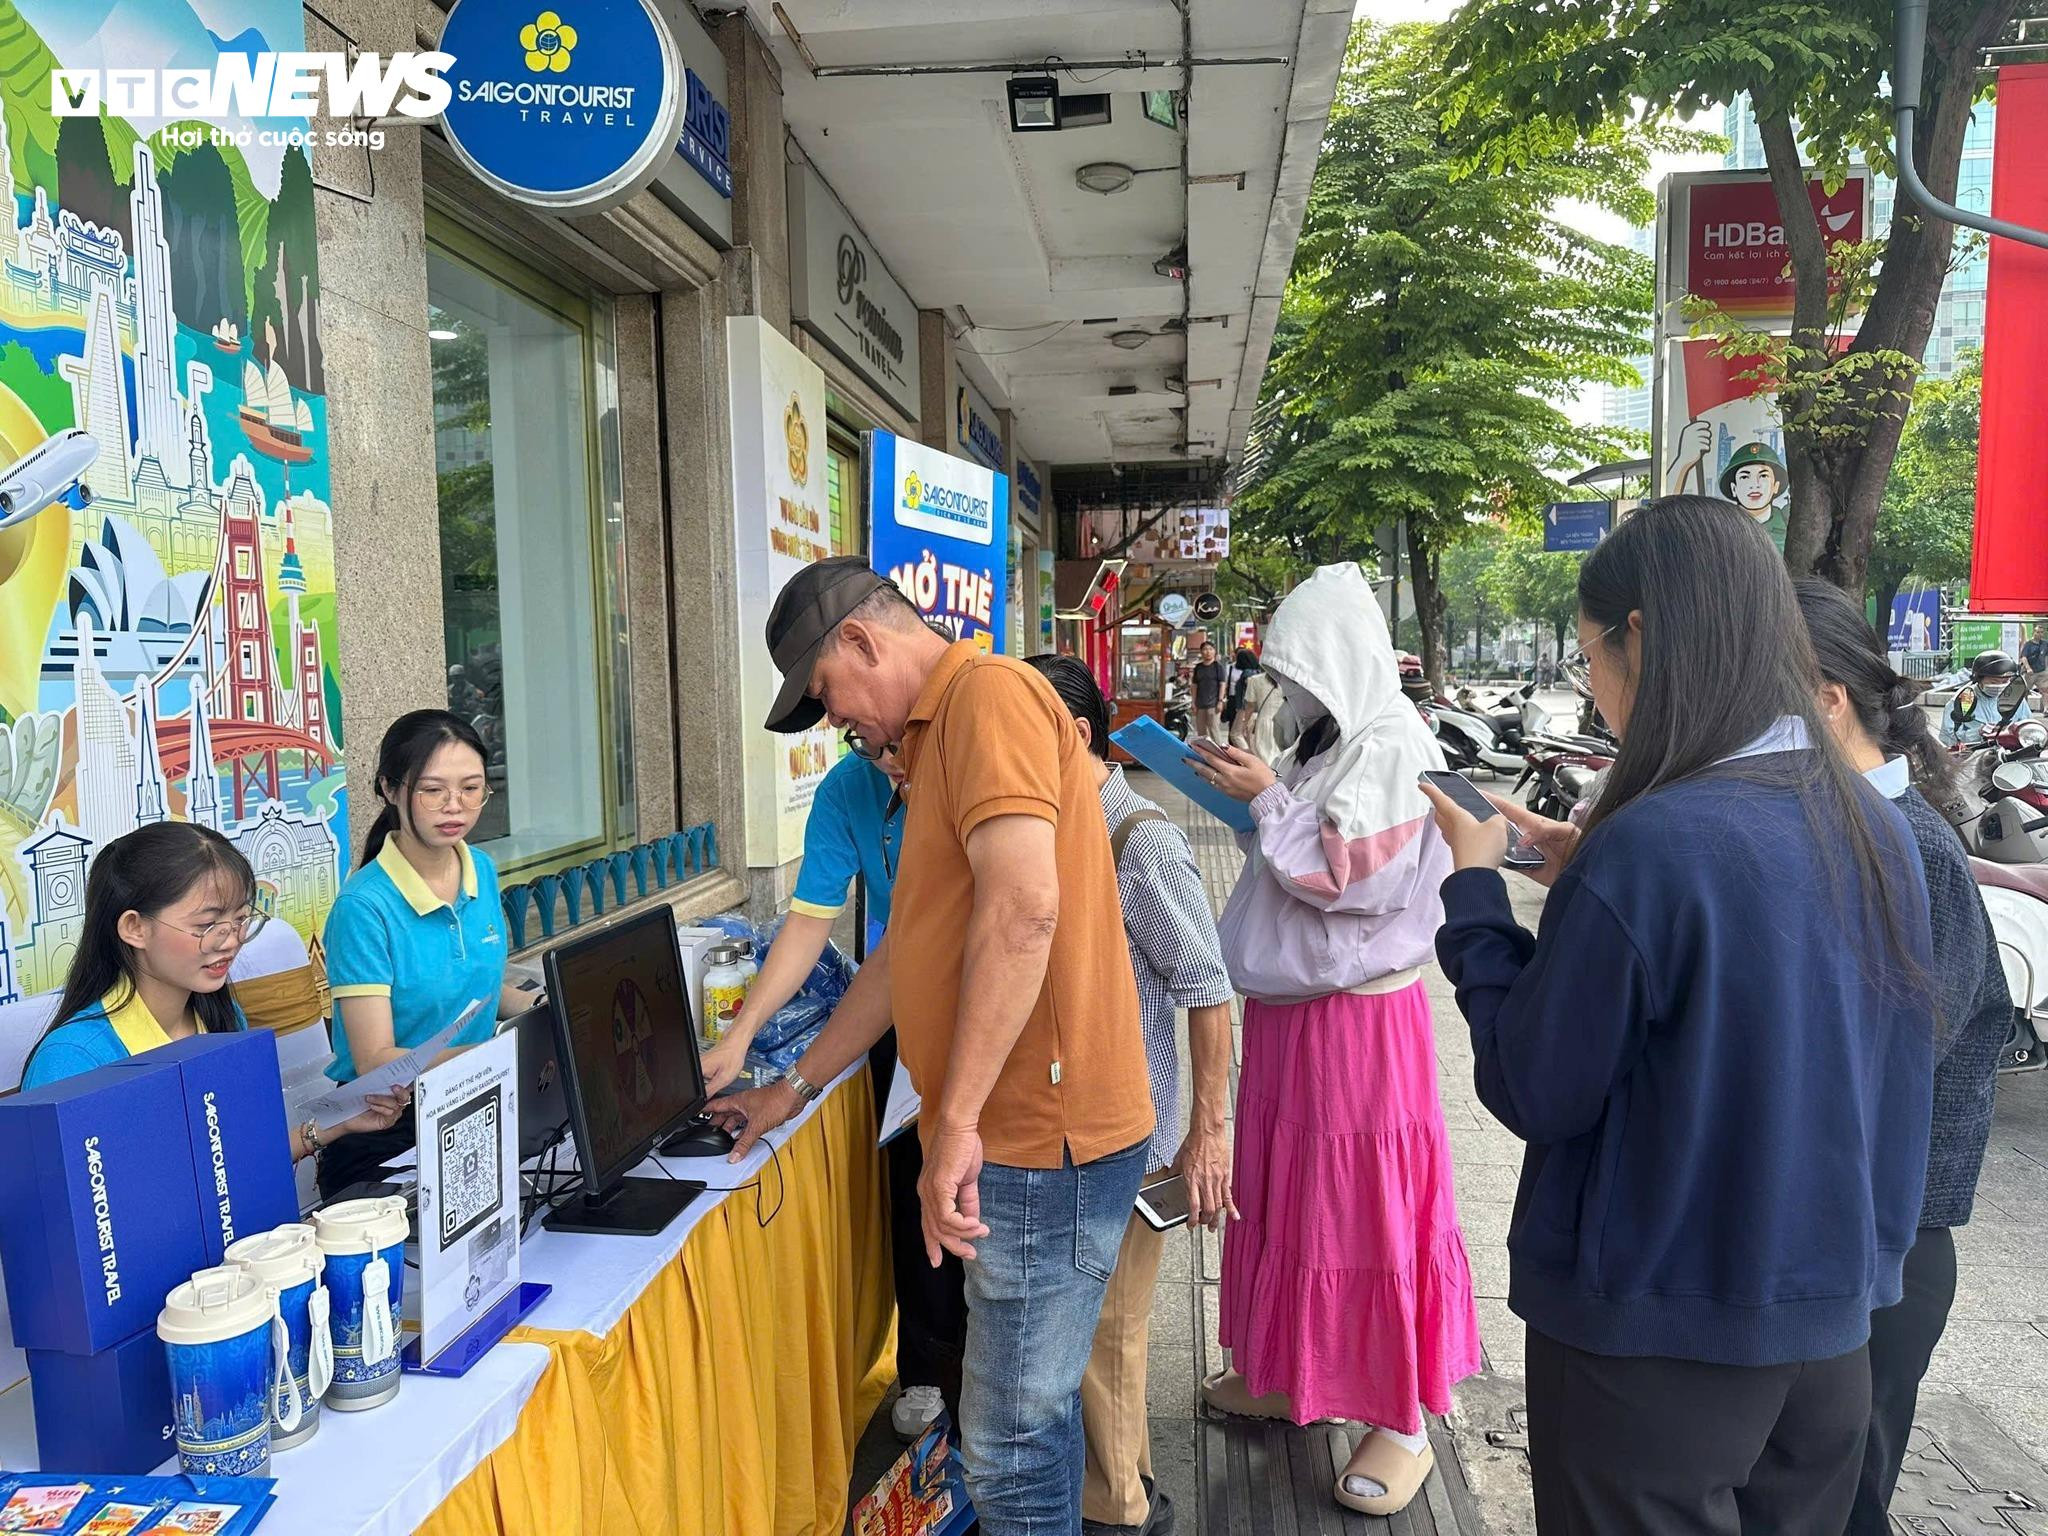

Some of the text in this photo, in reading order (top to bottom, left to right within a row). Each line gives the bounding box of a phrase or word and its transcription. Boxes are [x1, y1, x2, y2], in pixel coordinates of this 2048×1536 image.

[458, 79, 636, 109] SAIGONTOURIST
[520, 109, 636, 127] TRAVEL
[680, 129, 732, 191] ERVICE
[923, 482, 988, 518] SAIGONTOURIST
[889, 549, 993, 626] MỞ THẺ
[203, 1091, 235, 1247] SAIGONTOURIST TRAVEL
[84, 1136, 122, 1306] SAIGONTOURIST TRAVEL
